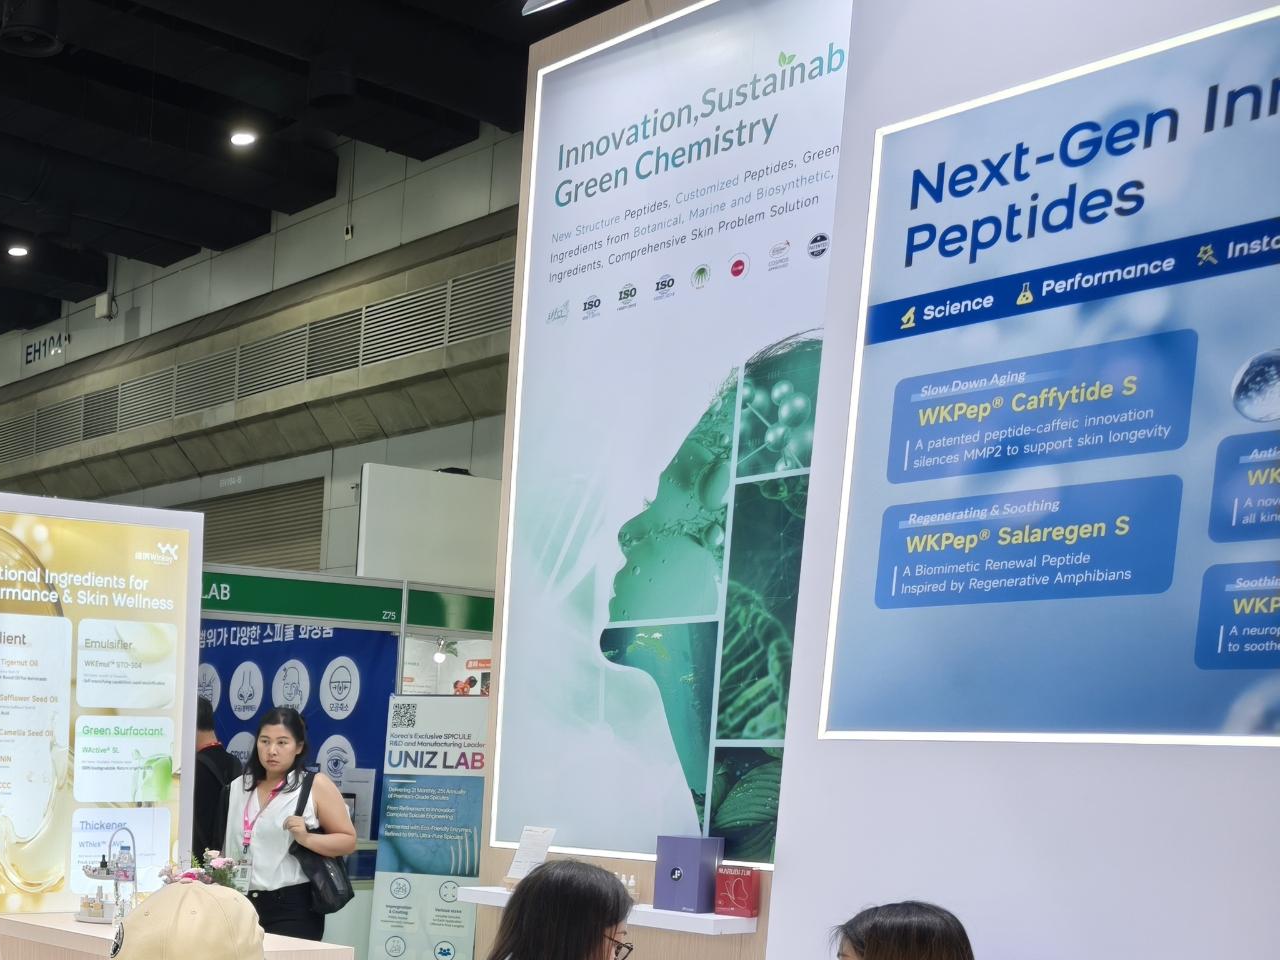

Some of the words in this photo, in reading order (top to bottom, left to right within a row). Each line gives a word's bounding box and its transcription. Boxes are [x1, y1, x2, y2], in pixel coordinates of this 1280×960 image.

[555, 166, 628, 207] Green
[635, 113, 779, 180] Chemistry
[909, 108, 1180, 210] Next-Gen
[551, 231, 572, 244] New
[575, 215, 621, 237] Structure
[624, 199, 671, 220] Peptides,
[675, 175, 739, 204] Customized
[744, 159, 797, 182] Peptides,
[802, 144, 840, 164] Green
[550, 240, 603, 264] Ingredients
[606, 231, 630, 246] from
[633, 213, 685, 238] Botanical,
[689, 201, 726, 221] Marine
[730, 193, 752, 208] and
[756, 169, 834, 201] Biosynthetic,
[904, 179, 1146, 268] Peptides
[549, 260, 604, 283] Ingredients,
[608, 234, 687, 265] Comprehensive
[691, 226, 714, 242] Skin
[719, 211, 765, 233] Problem
[770, 195, 819, 218] Solution
[618, 287, 637, 301] ISO
[655, 278, 675, 291] ISO
[922, 295, 995, 321] Science
[1041, 256, 1176, 297] Performance
[582, 298, 601, 312] ISO
[920, 385, 951, 398] Slow
[951, 379, 988, 392] Down
[990, 371, 1027, 386] Aging
[1011, 381, 1114, 413] Caffytide
[1122, 375, 1138, 397] S
[914, 440, 924, 451] A
[927, 431, 980, 451] patented
[984, 418, 1080, 443] peptide-caffeic
[1084, 408, 1154, 427] innovation
[913, 454, 960, 468] silences
[963, 445, 1002, 461] MMP2
[1006, 445, 1019, 456] to
[1023, 438, 1073, 455] support
[1077, 433, 1103, 447] skin
[1108, 424, 1172, 444] longevity
[908, 507, 988, 526] Regenerating
[989, 504, 1000, 516] &
[1002, 499, 1060, 515] Soothing
[1243, 498, 1253, 508] A
[1242, 512, 1256, 524] all
[997, 521, 1106, 545] Salaregen
[1114, 515, 1130, 535] S
[902, 566, 911, 577] A
[915, 561, 980, 577] Biomimetic
[984, 556, 1037, 571] Renewal
[1041, 552, 1091, 568] Peptide
[45, 568, 125, 589] Ingredients
[129, 575, 149, 590] for
[901, 580, 946, 596] Inspired
[950, 579, 965, 594] by
[969, 575, 1050, 592] Regenerative
[1054, 569, 1132, 586] Amphibians
[62, 590, 73, 604] &
[77, 590, 108, 606] Skin
[112, 592, 174, 610] Wellness
[201, 583, 230, 600] AB
[382, 611, 396, 620] Z75
[230, 625, 260, 646] 다양한
[1229, 625, 1238, 636] A
[84, 638, 133, 650] Emulsifier
[1228, 641, 1240, 652] to
[32, 695, 48, 703] Seed
[27, 729, 43, 737] Seed
[82, 725, 111, 736] Green
[113, 725, 164, 736] Surfactant
[417, 740, 462, 748] Manufacturing
[387, 750, 438, 768] UNIZ
[442, 751, 485, 770] LAB
